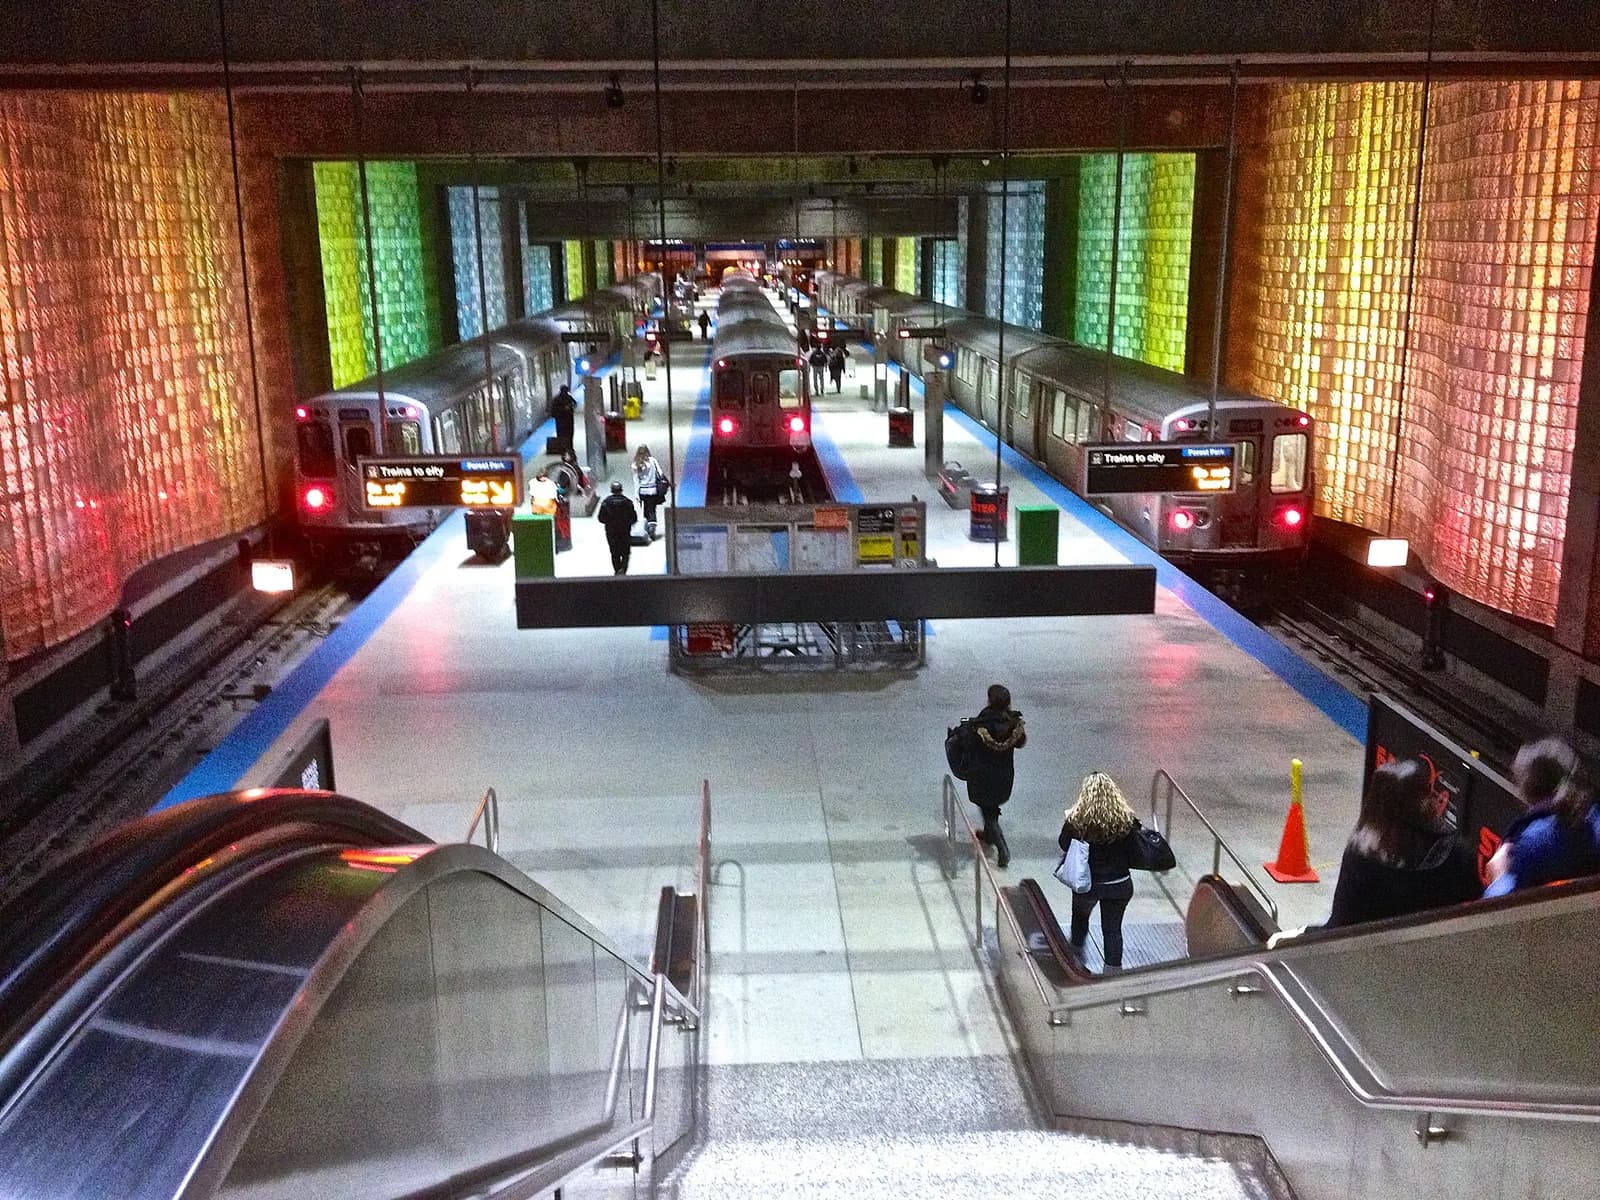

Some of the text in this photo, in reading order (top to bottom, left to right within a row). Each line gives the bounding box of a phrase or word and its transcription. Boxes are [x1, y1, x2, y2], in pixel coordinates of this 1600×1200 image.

[1104, 452, 1165, 464] Trains to city
[1187, 448, 1225, 457] Forest Park
[380, 466, 444, 478] Trains to city
